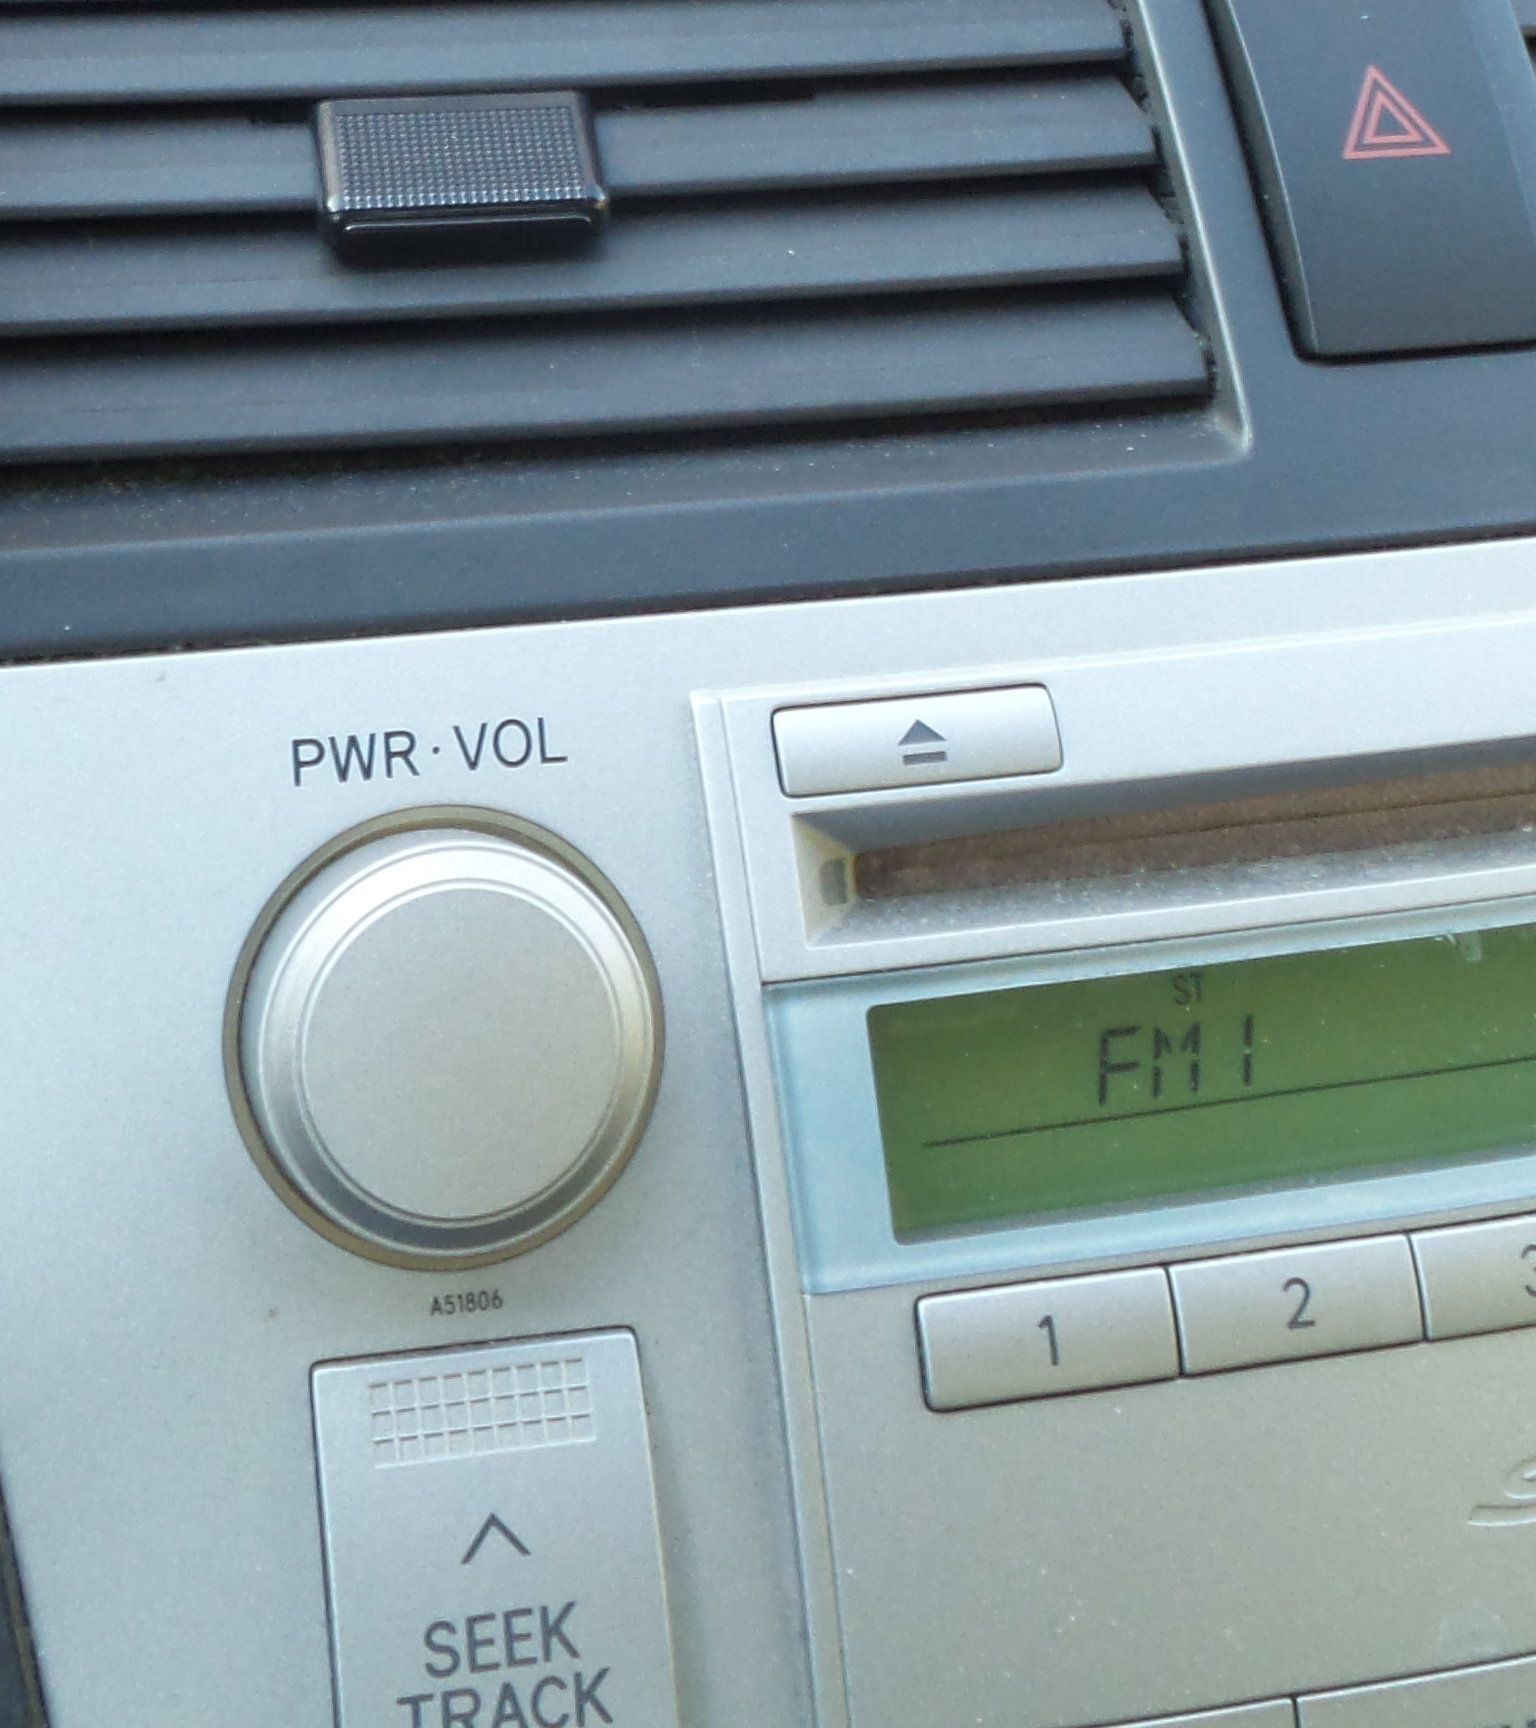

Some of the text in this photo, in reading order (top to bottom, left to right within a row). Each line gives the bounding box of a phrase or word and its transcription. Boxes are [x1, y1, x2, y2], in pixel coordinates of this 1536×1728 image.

[1171, 971, 1204, 1005] ST
[429, 1288, 505, 1318] A51806
[1282, 1277, 1317, 1331] 2
[1038, 1314, 1061, 1367] 1
[423, 1600, 581, 1679] SEEK
[395, 1667, 614, 1728] TRACK
